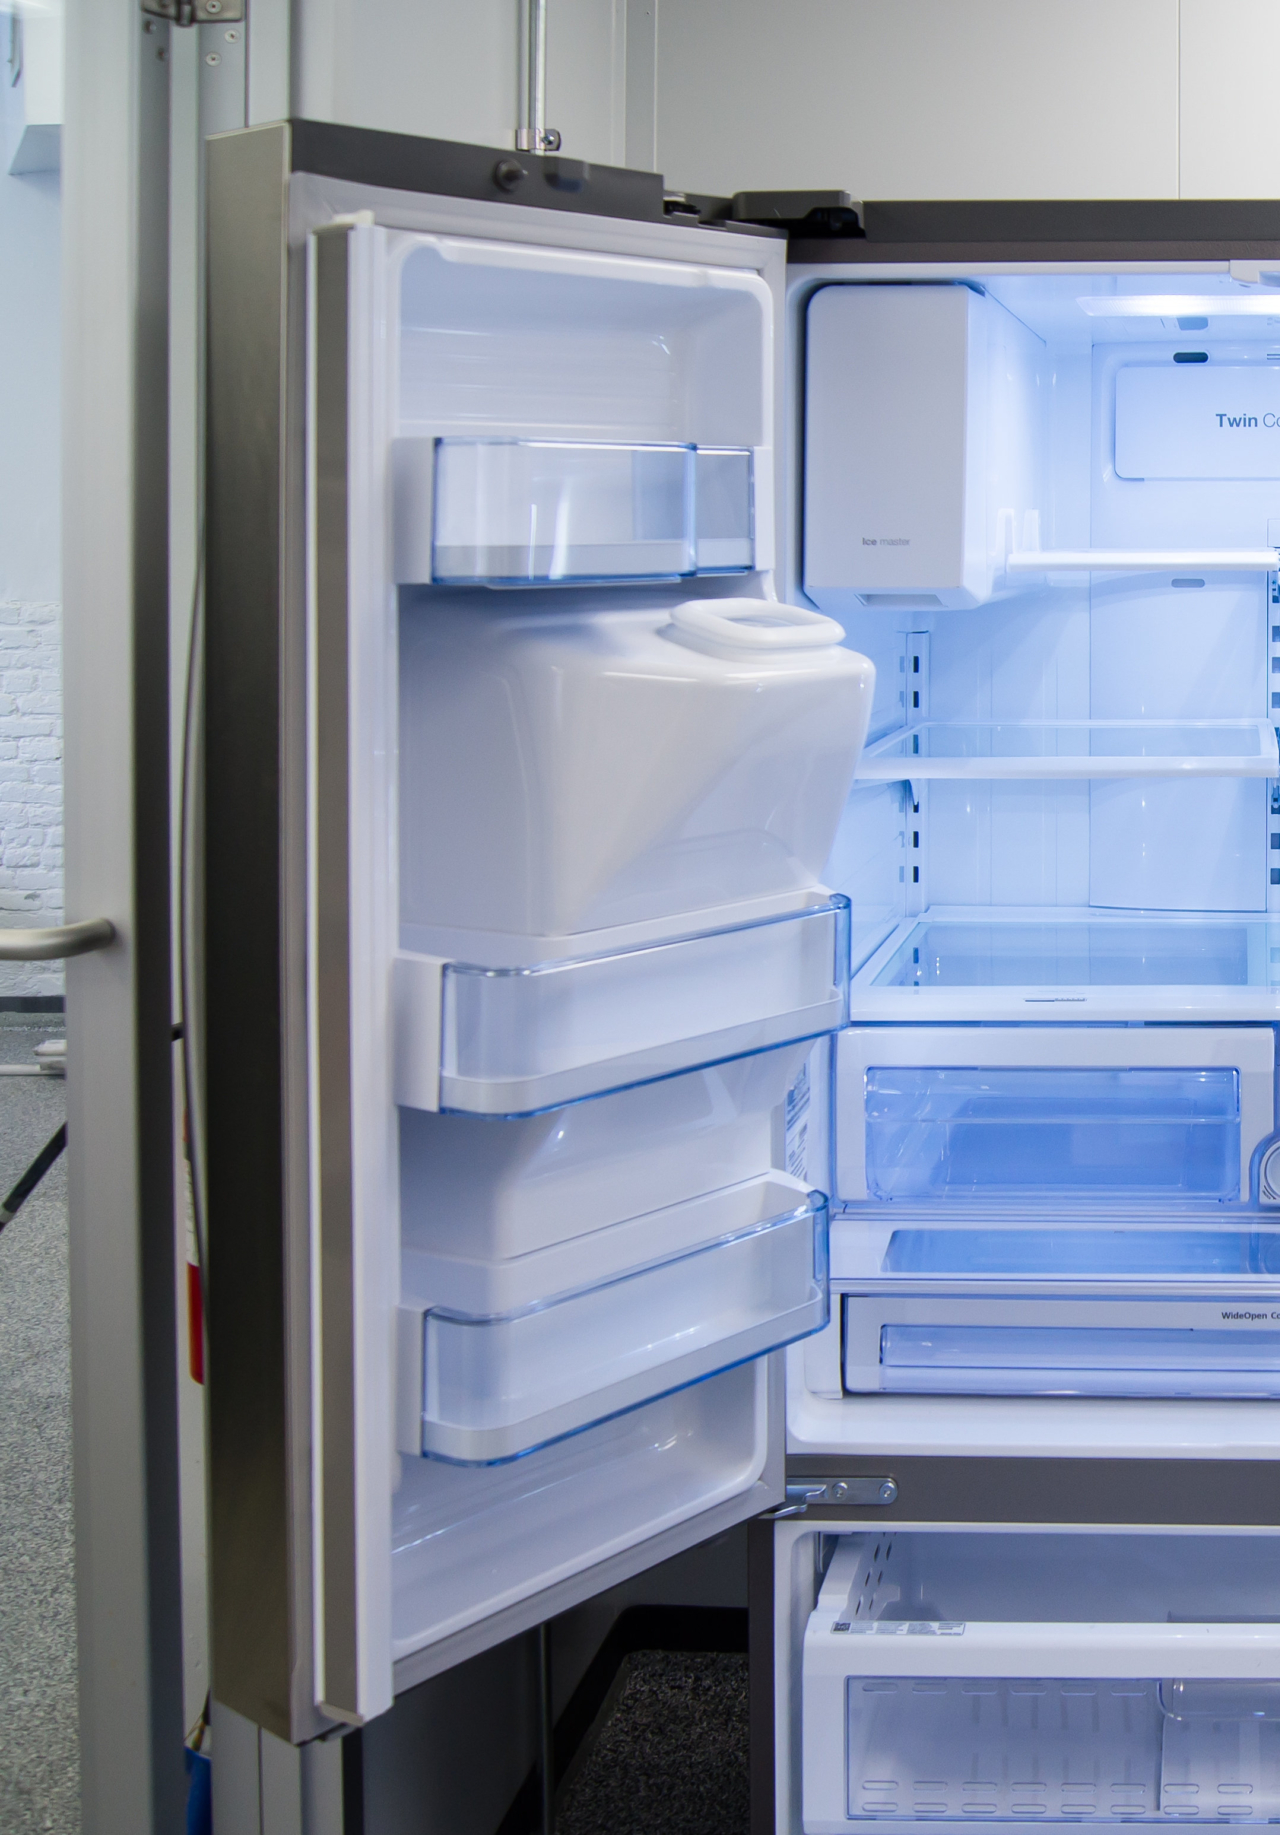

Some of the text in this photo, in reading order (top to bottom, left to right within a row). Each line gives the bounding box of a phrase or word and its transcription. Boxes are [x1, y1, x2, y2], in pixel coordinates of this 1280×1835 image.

[1215, 413, 1258, 428] Twin
[862, 537, 910, 546] Ice master
[1221, 1311, 1268, 1321] WideOpen
